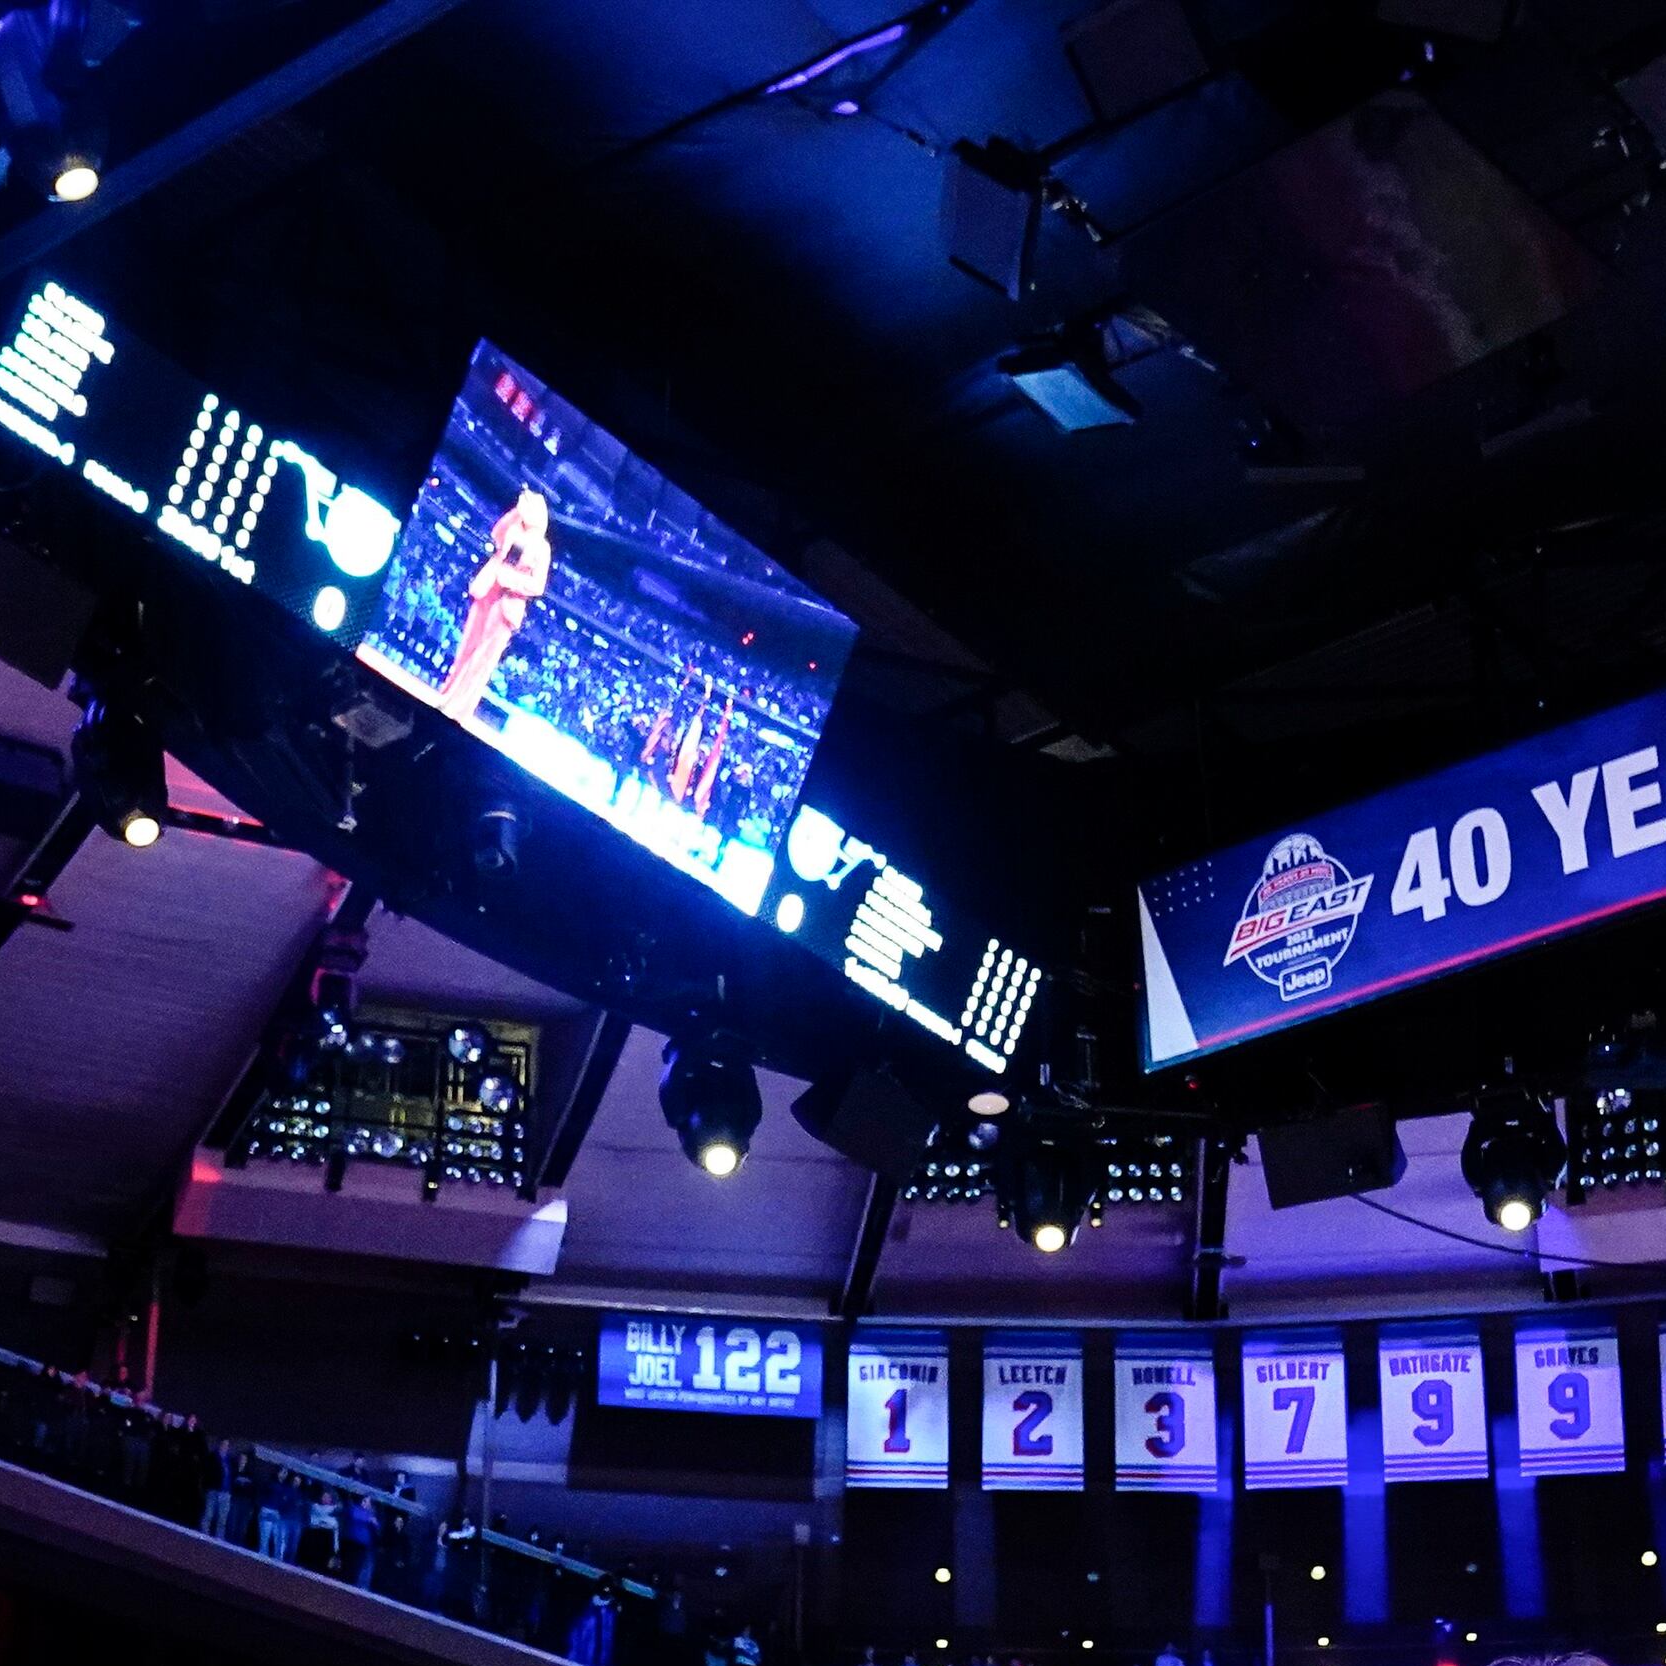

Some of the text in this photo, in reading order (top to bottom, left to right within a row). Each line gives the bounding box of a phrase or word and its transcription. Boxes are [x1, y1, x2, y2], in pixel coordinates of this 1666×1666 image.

[1390, 806, 1513, 923] 40
[1235, 909, 1288, 943] BIG
[1289, 880, 1369, 924] EAST
[1255, 927, 1350, 969] TOURNAMENT
[1284, 967, 1327, 992] Jeep
[626, 1320, 686, 1355] BILLY
[692, 1325, 801, 1395] 122
[628, 1353, 682, 1389] JOEL
[998, 1364, 1068, 1387] LEETCH
[1255, 1361, 1331, 1383] GILBERT
[883, 1388, 911, 1454] 1
[1012, 1389, 1054, 1457] 2
[1145, 1391, 1186, 1459] 3
[1272, 1385, 1316, 1455] 7
[1410, 1378, 1455, 1448] 9
[1547, 1372, 1591, 1441] 9
